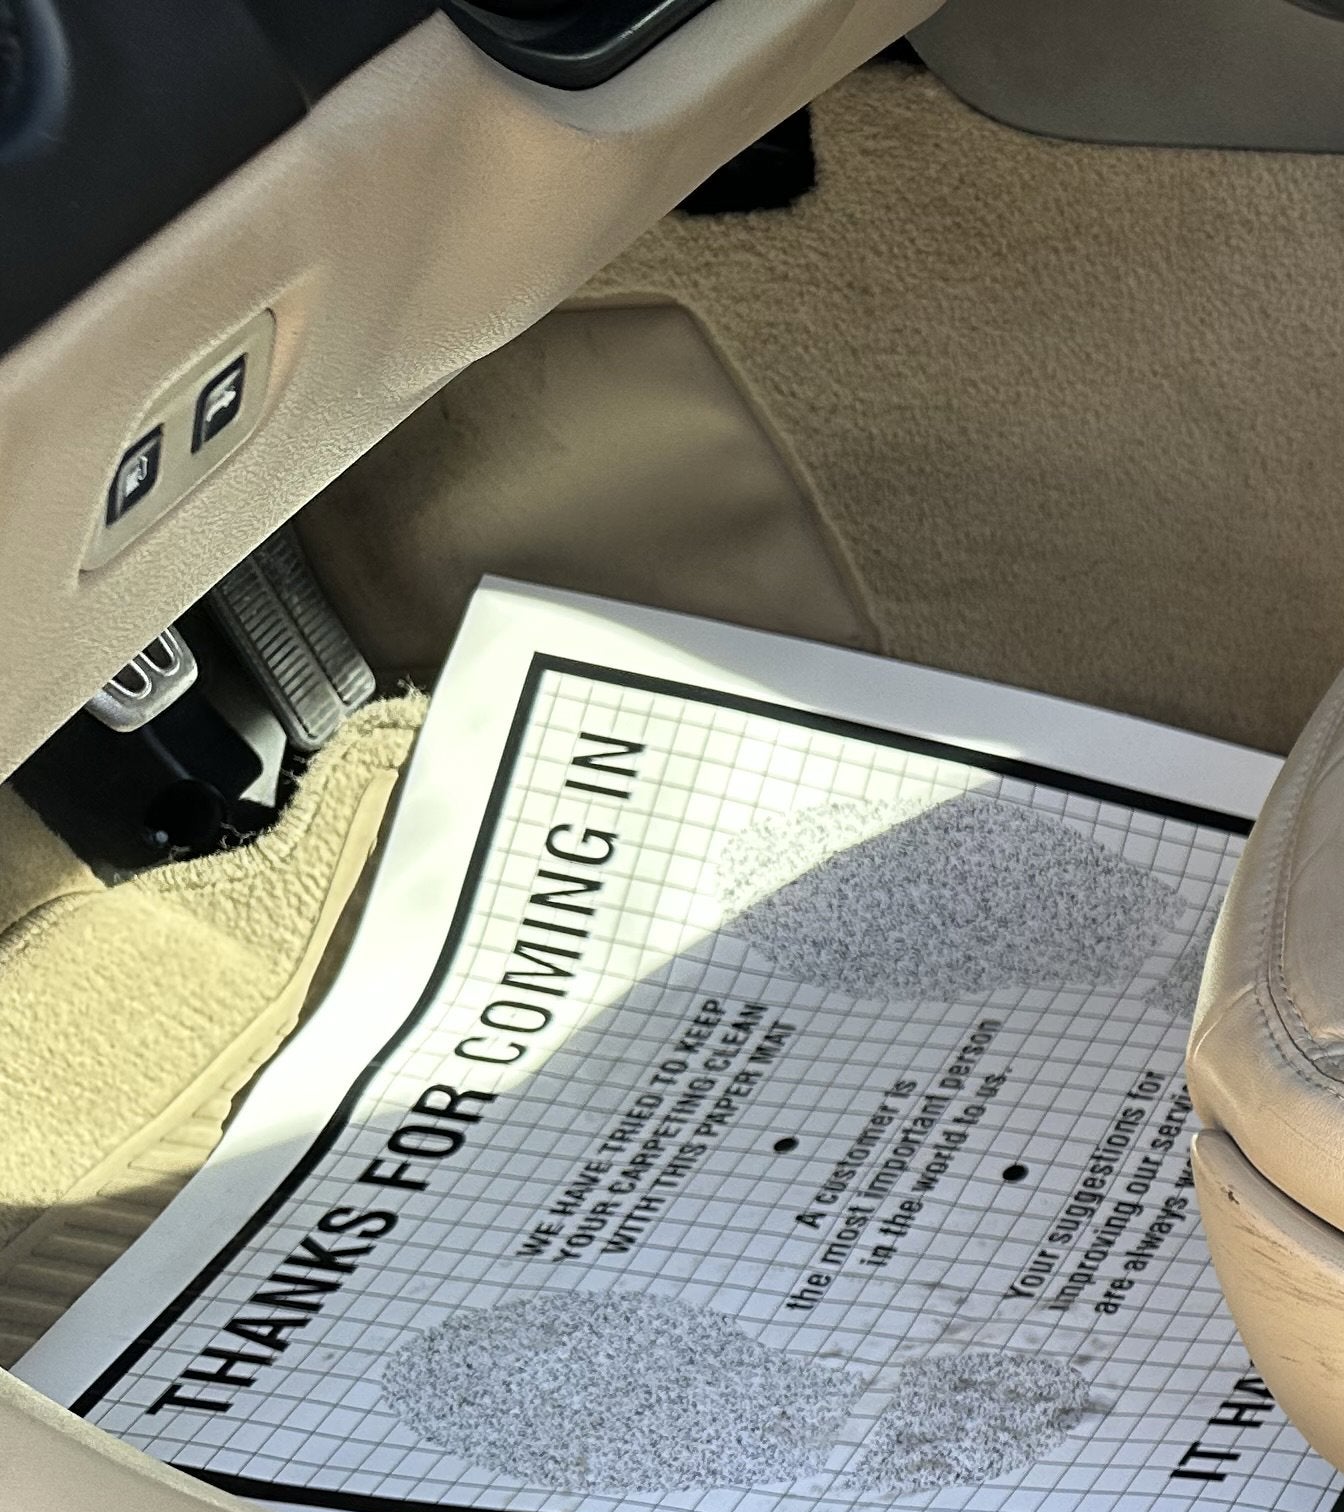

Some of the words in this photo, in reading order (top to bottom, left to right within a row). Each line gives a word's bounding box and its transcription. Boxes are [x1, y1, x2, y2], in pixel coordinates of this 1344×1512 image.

[145, 1207, 399, 1415] THANKS
[358, 1084, 500, 1191] FOR
[454, 824, 619, 1064] COMING
[565, 731, 646, 799] IN
[516, 1222, 563, 1257] WE
[550, 1160, 613, 1216] HAVE
[600, 1093, 664, 1153] TRIED
[651, 1059, 688, 1085] TO
[674, 999, 725, 1053] KEEP
[552, 1200, 621, 1263] YOUR
[609, 1077, 717, 1196] CARPETING
[704, 1002, 769, 1072] CLEAN
[602, 1195, 666, 1254] WITH
[652, 1142, 707, 1188] THIS
[694, 1070, 764, 1137] PAPER
[750, 1020, 797, 1064] MAT
[786, 1273, 832, 1311] the
[821, 1205, 876, 1266] most
[856, 1093, 951, 1200] important
[939, 1018, 1001, 1090] person
[796, 1211, 827, 1230] A
[816, 1102, 900, 1204] customer
[885, 1080, 917, 1099] is
[859, 1243, 898, 1267] in
[879, 1200, 924, 1237] the
[912, 1129, 969, 1192] world
[952, 1103, 987, 1125] to
[977, 1067, 1013, 1098] us.
[1002, 1249, 1060, 1299] Your
[1049, 1107, 1145, 1244] suggestions
[1127, 1071, 1166, 1101] for
[1048, 1199, 1144, 1312] improving
[1126, 1156, 1163, 1195] our
[1151, 1084, 1193, 1152] servi
[1094, 1276, 1135, 1315] are
[1124, 1196, 1189, 1272] always
[1170, 1440, 1241, 1482] IT
[1207, 1359, 1275, 1428] HA
